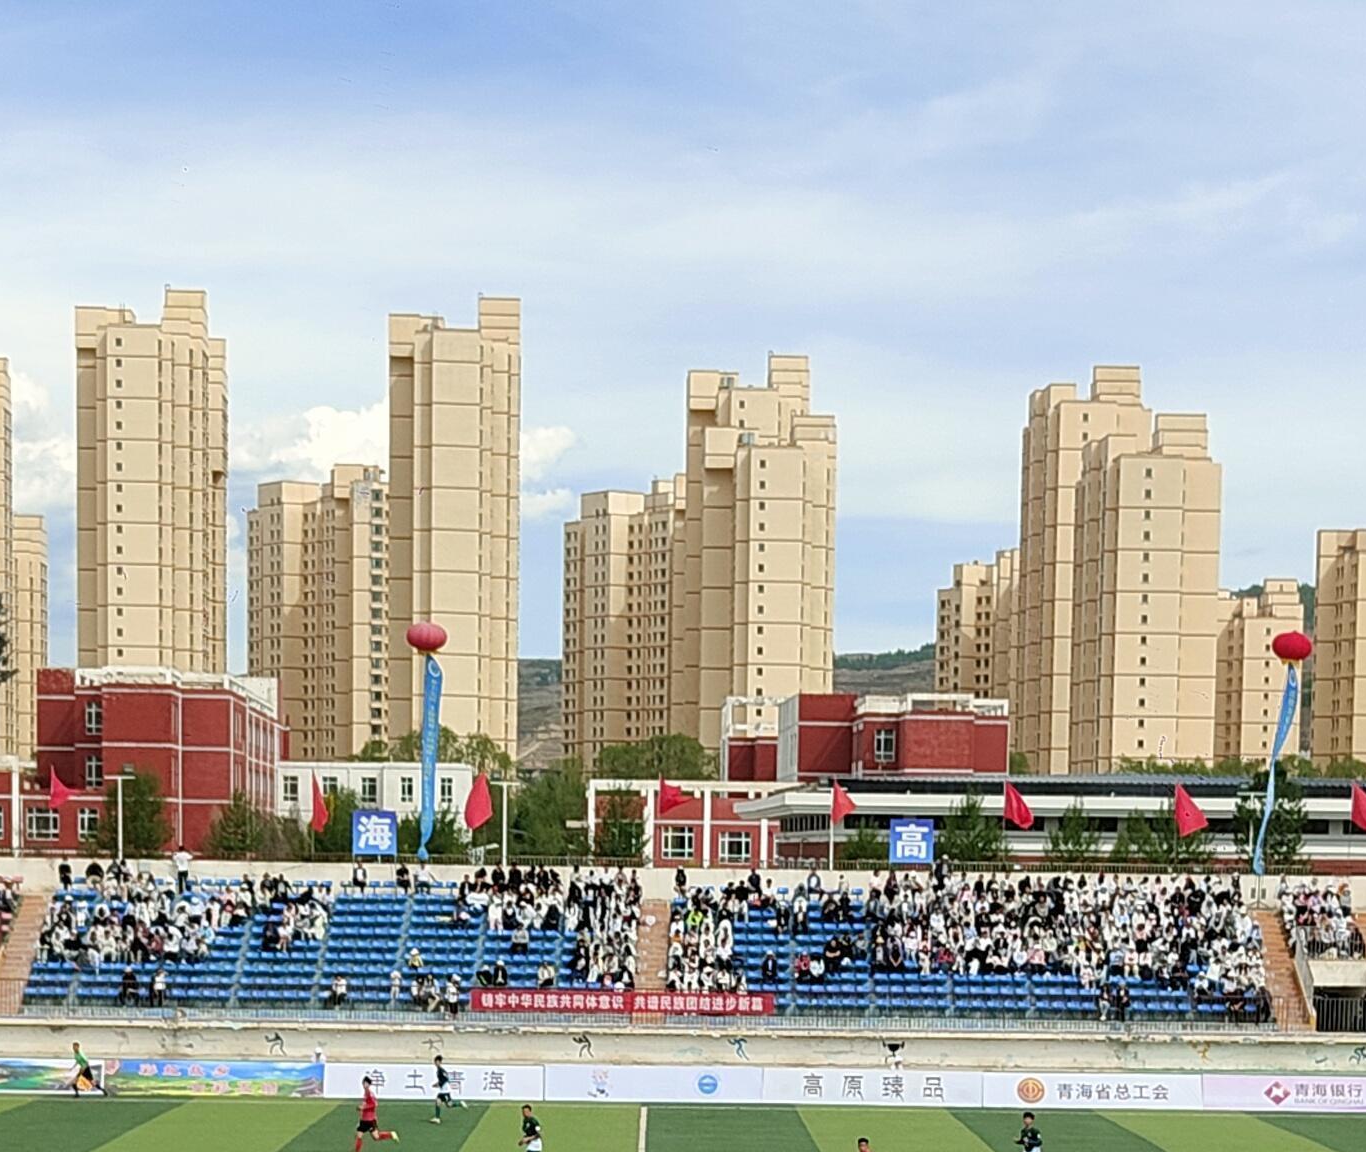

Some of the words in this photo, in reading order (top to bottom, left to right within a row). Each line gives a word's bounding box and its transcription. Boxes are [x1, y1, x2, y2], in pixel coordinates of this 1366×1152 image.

[357, 815, 393, 851] 海
[894, 823, 929, 860] 高
[802, 1072, 945, 1103] 高原臻品
[1056, 1082, 1170, 1102] 青海省总工会
[1294, 1082, 1365, 1098] 青海银行
